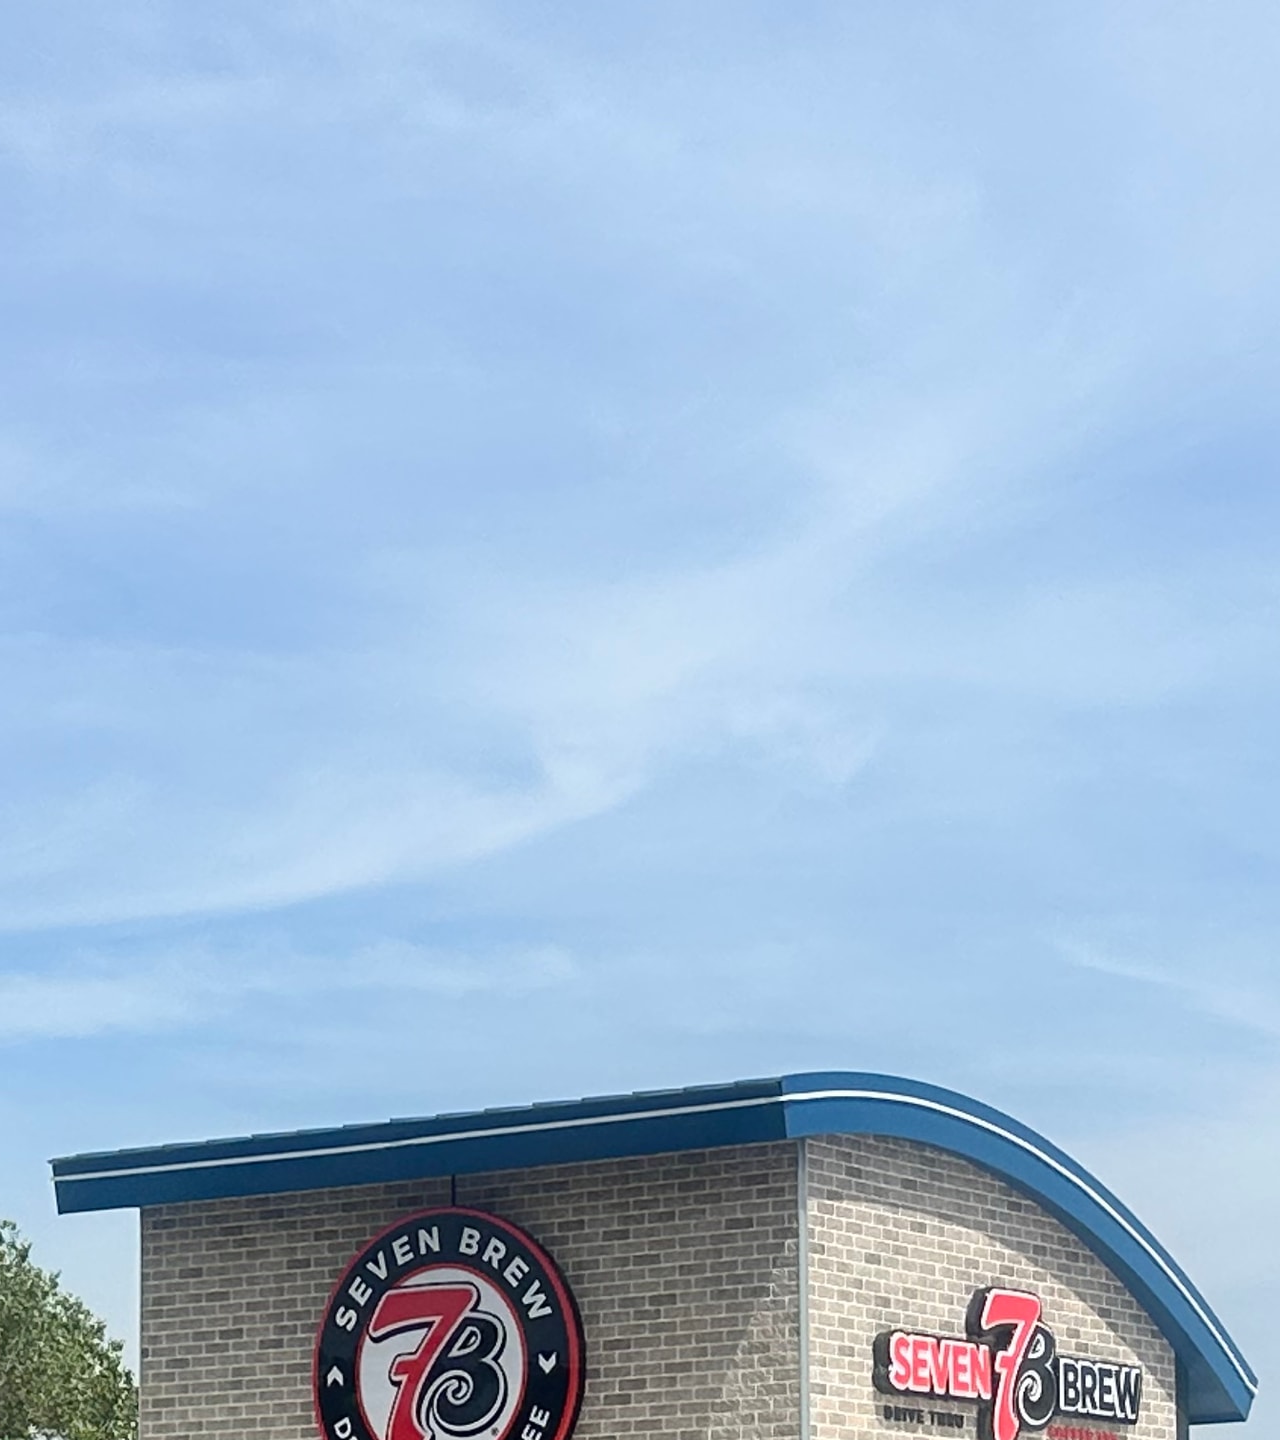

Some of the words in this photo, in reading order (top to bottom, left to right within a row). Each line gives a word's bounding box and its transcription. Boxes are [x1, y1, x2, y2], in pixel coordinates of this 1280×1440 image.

[335, 1226, 441, 1332] SEVEN
[459, 1227, 553, 1320] BREW
[883, 1405, 925, 1424] DRIVE
[928, 1410, 965, 1429] THRU
[889, 1331, 993, 1400] SEVEN
[1059, 1357, 1142, 1421] BREW
